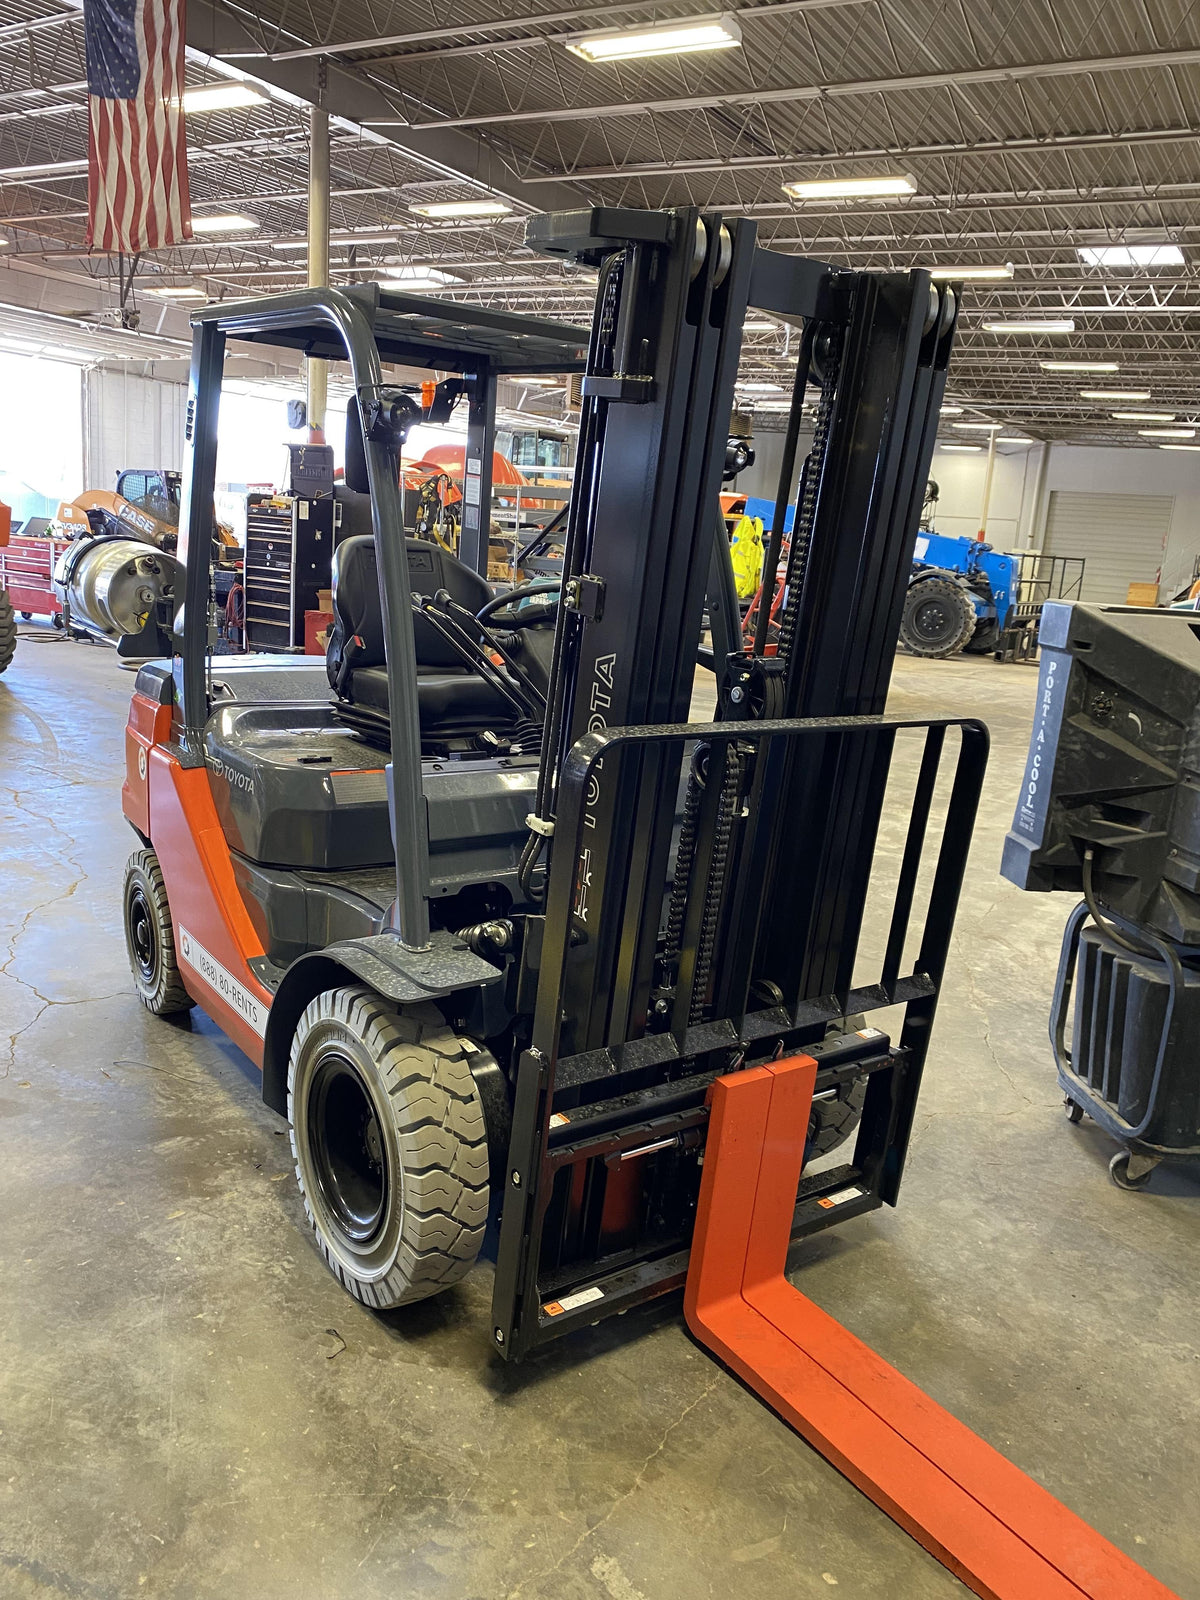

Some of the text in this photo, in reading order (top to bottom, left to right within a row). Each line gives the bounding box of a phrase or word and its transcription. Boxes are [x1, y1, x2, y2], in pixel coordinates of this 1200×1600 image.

[118, 504, 155, 534] CASE
[584, 653, 617, 829] OOTA
[224, 765, 255, 795] TOYOTA
[199, 954, 258, 1023] (888) 80-RENTS
